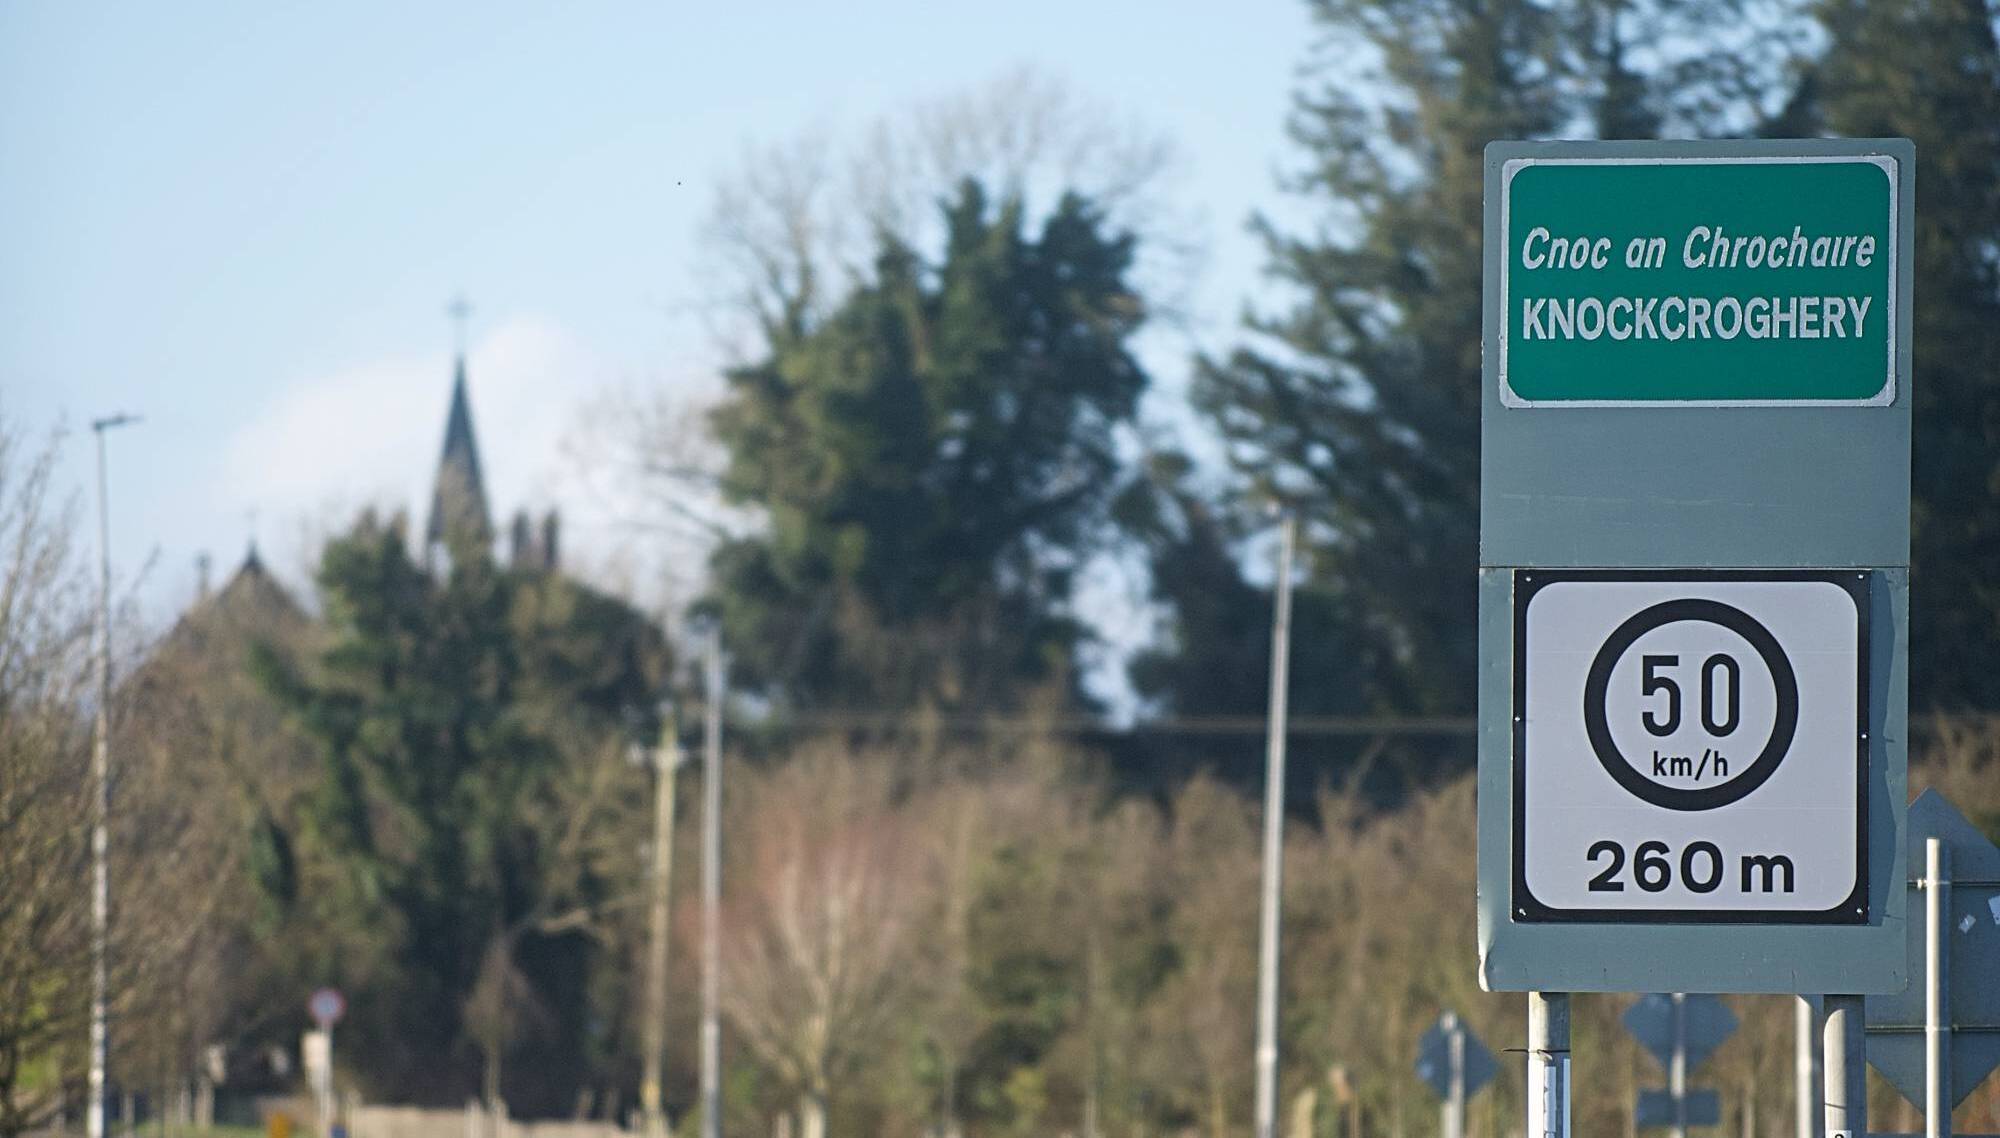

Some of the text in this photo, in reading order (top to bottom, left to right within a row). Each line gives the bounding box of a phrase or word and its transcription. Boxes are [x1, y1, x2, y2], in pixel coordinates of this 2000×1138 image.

[1522, 226, 1612, 270] Cnoc
[1625, 237, 1667, 269] an
[1522, 296, 1872, 342] KNOCKCROGHERY
[1642, 653, 1740, 738] 50
[1652, 748, 1729, 782] km/h
[1586, 840, 1795, 894] 260 m
